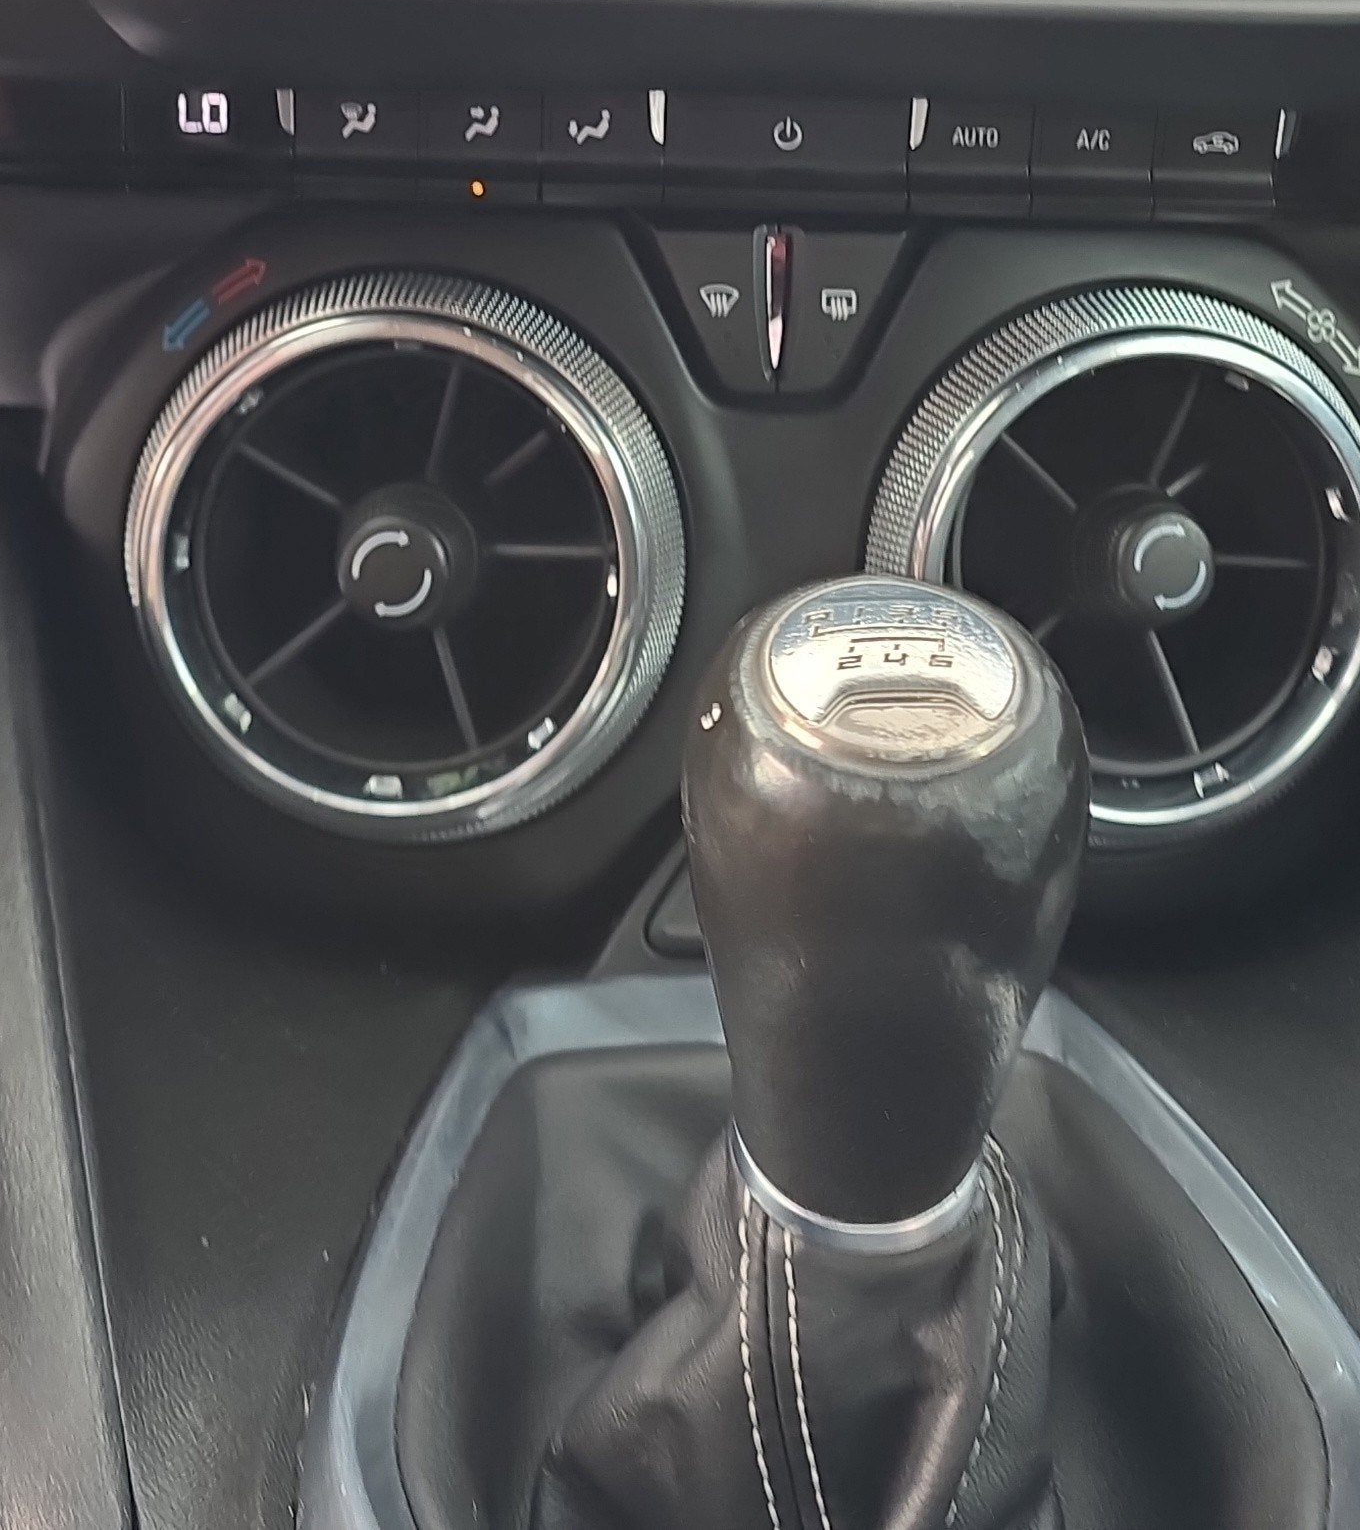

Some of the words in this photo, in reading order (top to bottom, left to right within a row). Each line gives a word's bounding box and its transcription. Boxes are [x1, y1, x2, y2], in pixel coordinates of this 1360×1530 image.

[177, 92, 228, 134] LO
[952, 125, 999, 149] AUTO
[1076, 127, 1111, 152] A/C
[837, 653, 863, 671] 2
[883, 652, 909, 667] 4
